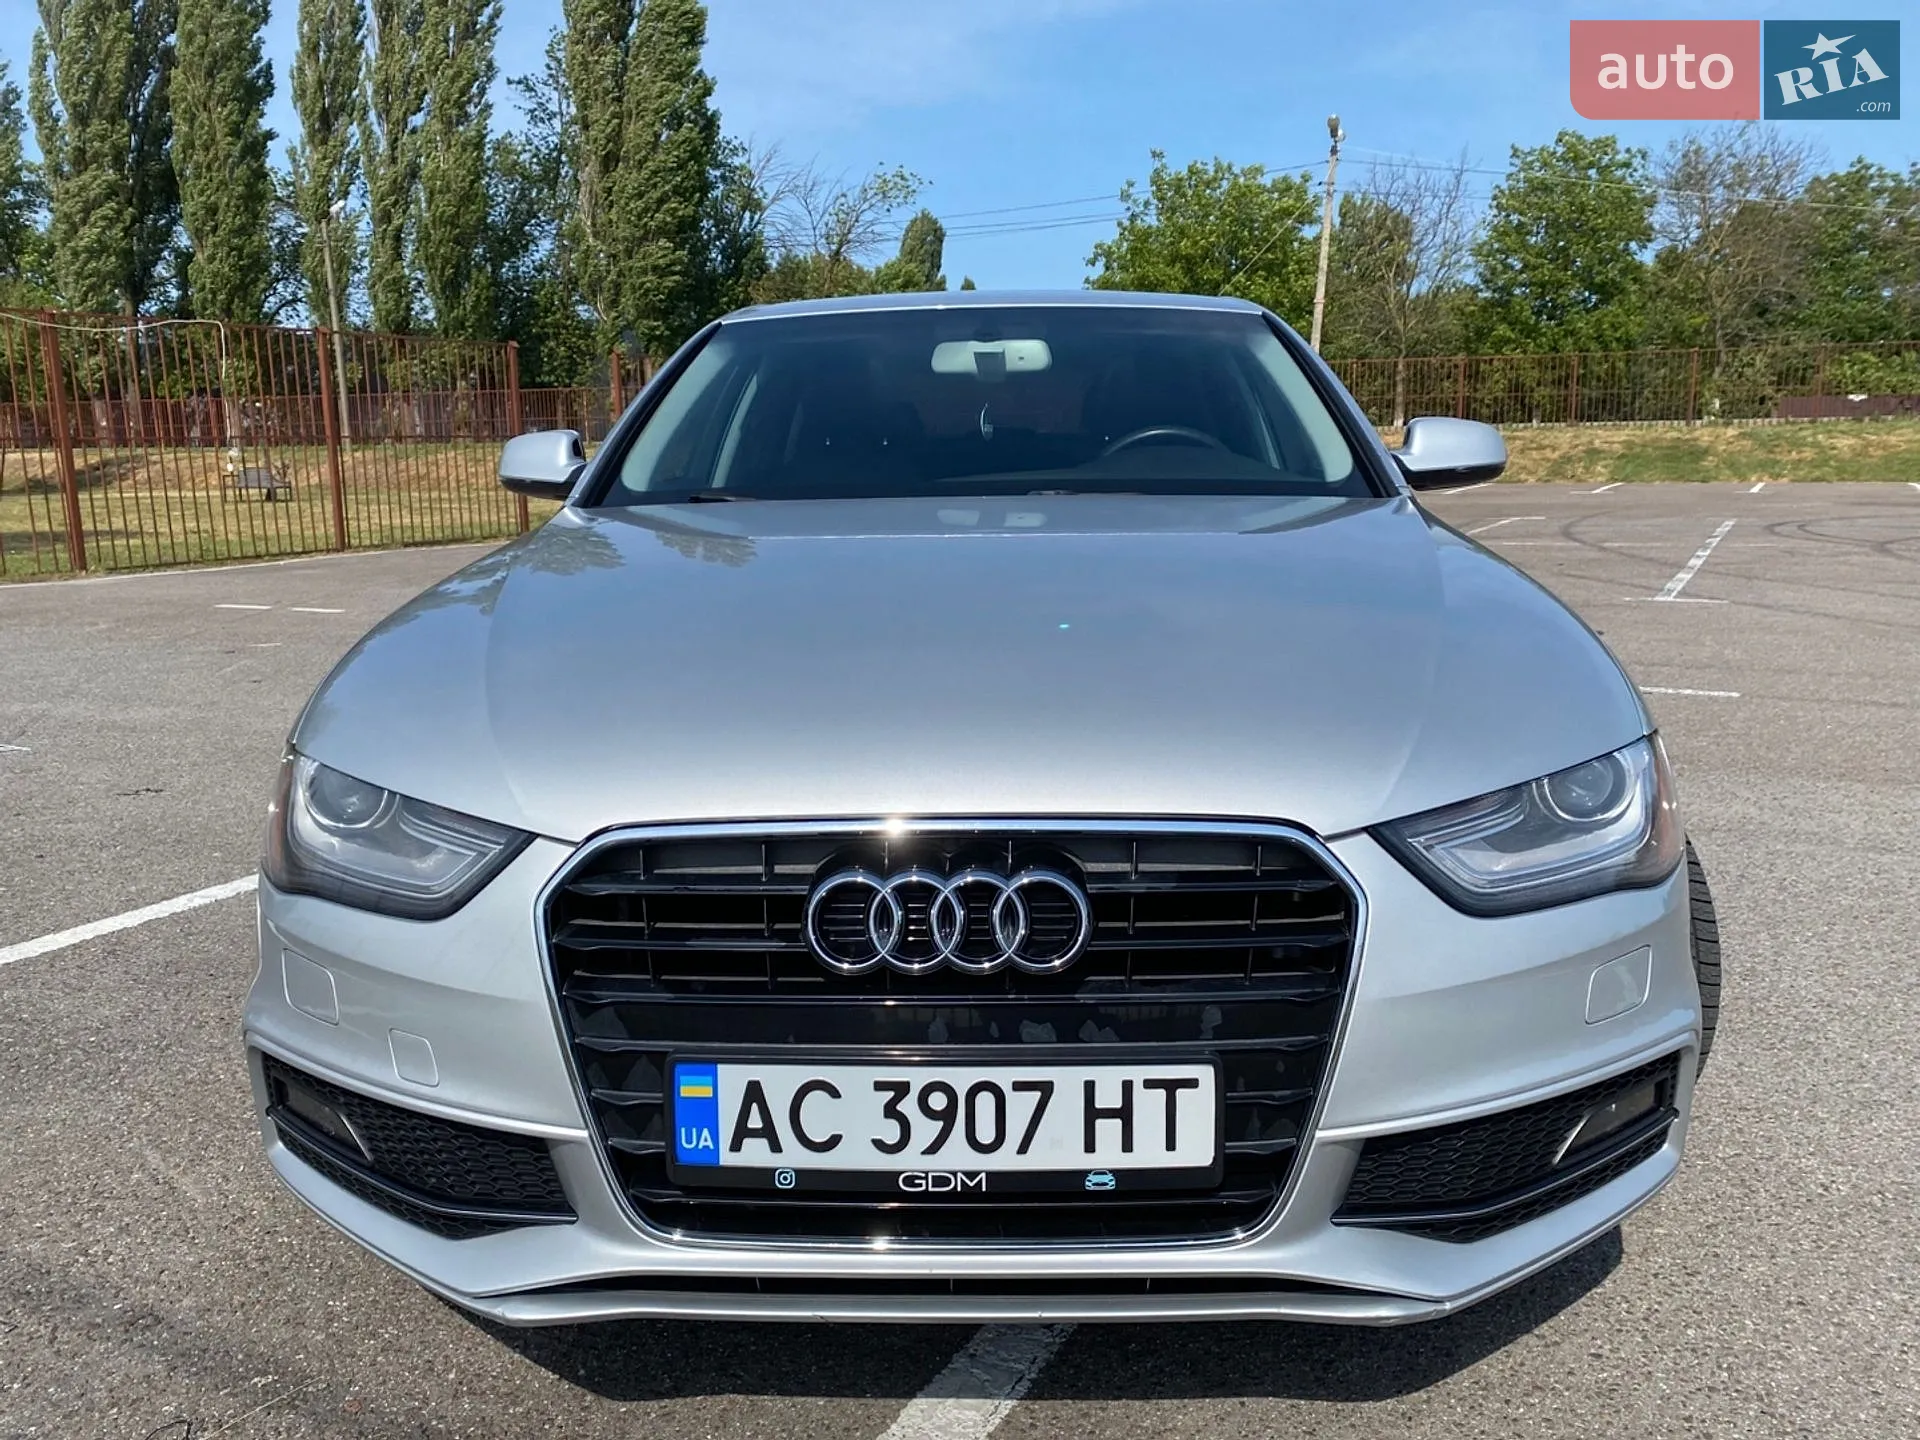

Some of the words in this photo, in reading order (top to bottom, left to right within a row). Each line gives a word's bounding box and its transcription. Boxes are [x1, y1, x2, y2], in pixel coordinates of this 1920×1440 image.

[728, 1079, 843, 1153] AC
[870, 1080, 1055, 1155] 3907
[1083, 1078, 1200, 1153] HT
[681, 1128, 714, 1150] UA
[898, 1171, 987, 1193] GDM
